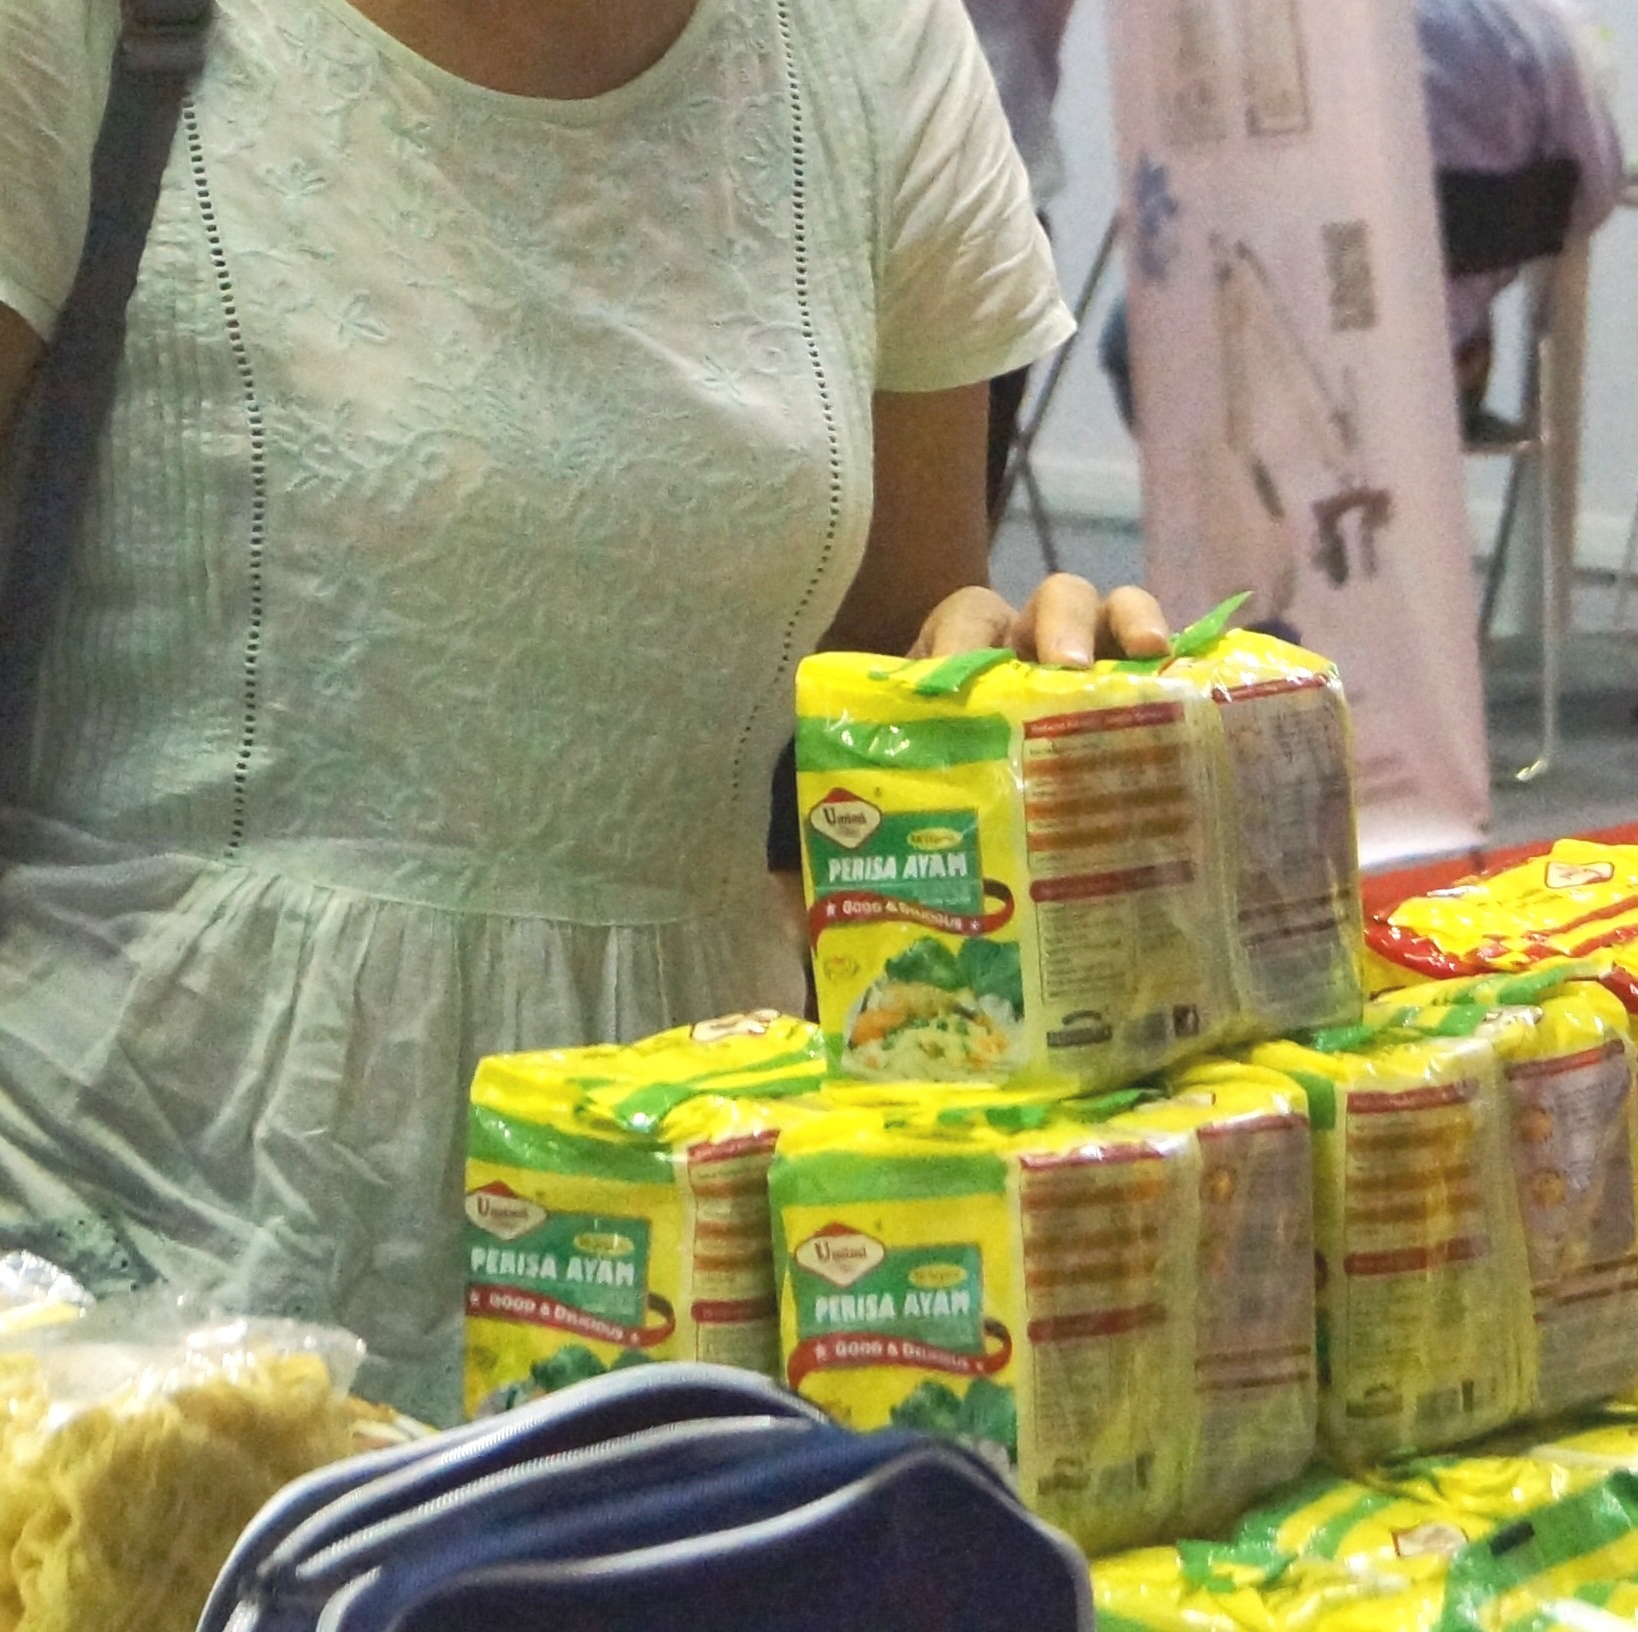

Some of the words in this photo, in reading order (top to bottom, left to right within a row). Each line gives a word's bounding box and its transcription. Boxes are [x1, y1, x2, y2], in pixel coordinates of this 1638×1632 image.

[827, 854, 898, 883] PERISA
[902, 851, 968, 880] AYAM
[470, 1246, 557, 1280] PERISA
[566, 1255, 635, 1287] AYAM
[489, 1291, 537, 1314] GOOD
[815, 1292, 896, 1323] PERISA
[903, 1289, 970, 1317] AYAM
[835, 1340, 883, 1357] GOOD
